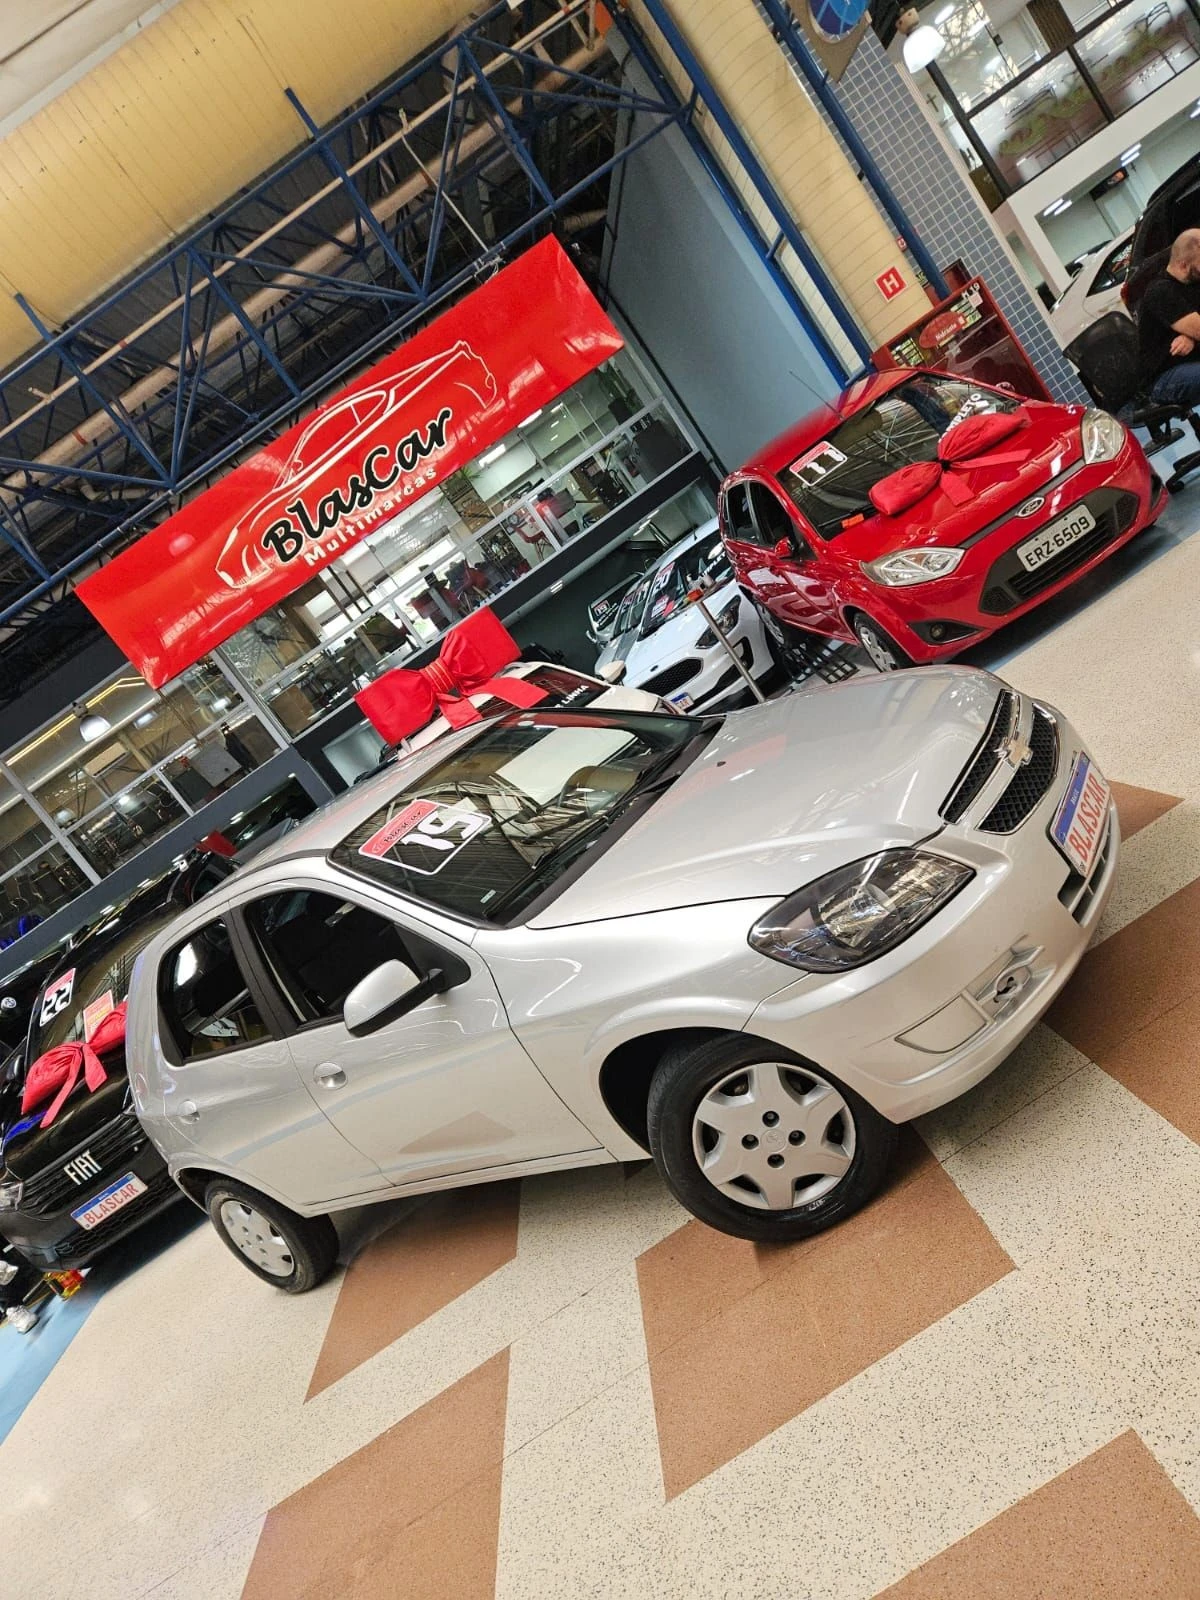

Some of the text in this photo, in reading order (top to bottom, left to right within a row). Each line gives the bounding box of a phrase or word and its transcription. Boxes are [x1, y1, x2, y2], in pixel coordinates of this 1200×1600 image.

[883, 273, 900, 294] H
[806, 449, 844, 475] 11
[263, 407, 452, 563] BlasCar
[303, 467, 437, 567] Multimarcas
[561, 684, 589, 704] LINHA
[1068, 773, 1107, 862] BLASCAR
[41, 983, 72, 1025] 22
[64, 1149, 102, 1185] FIAT
[83, 1183, 139, 1224] BLASCAR
